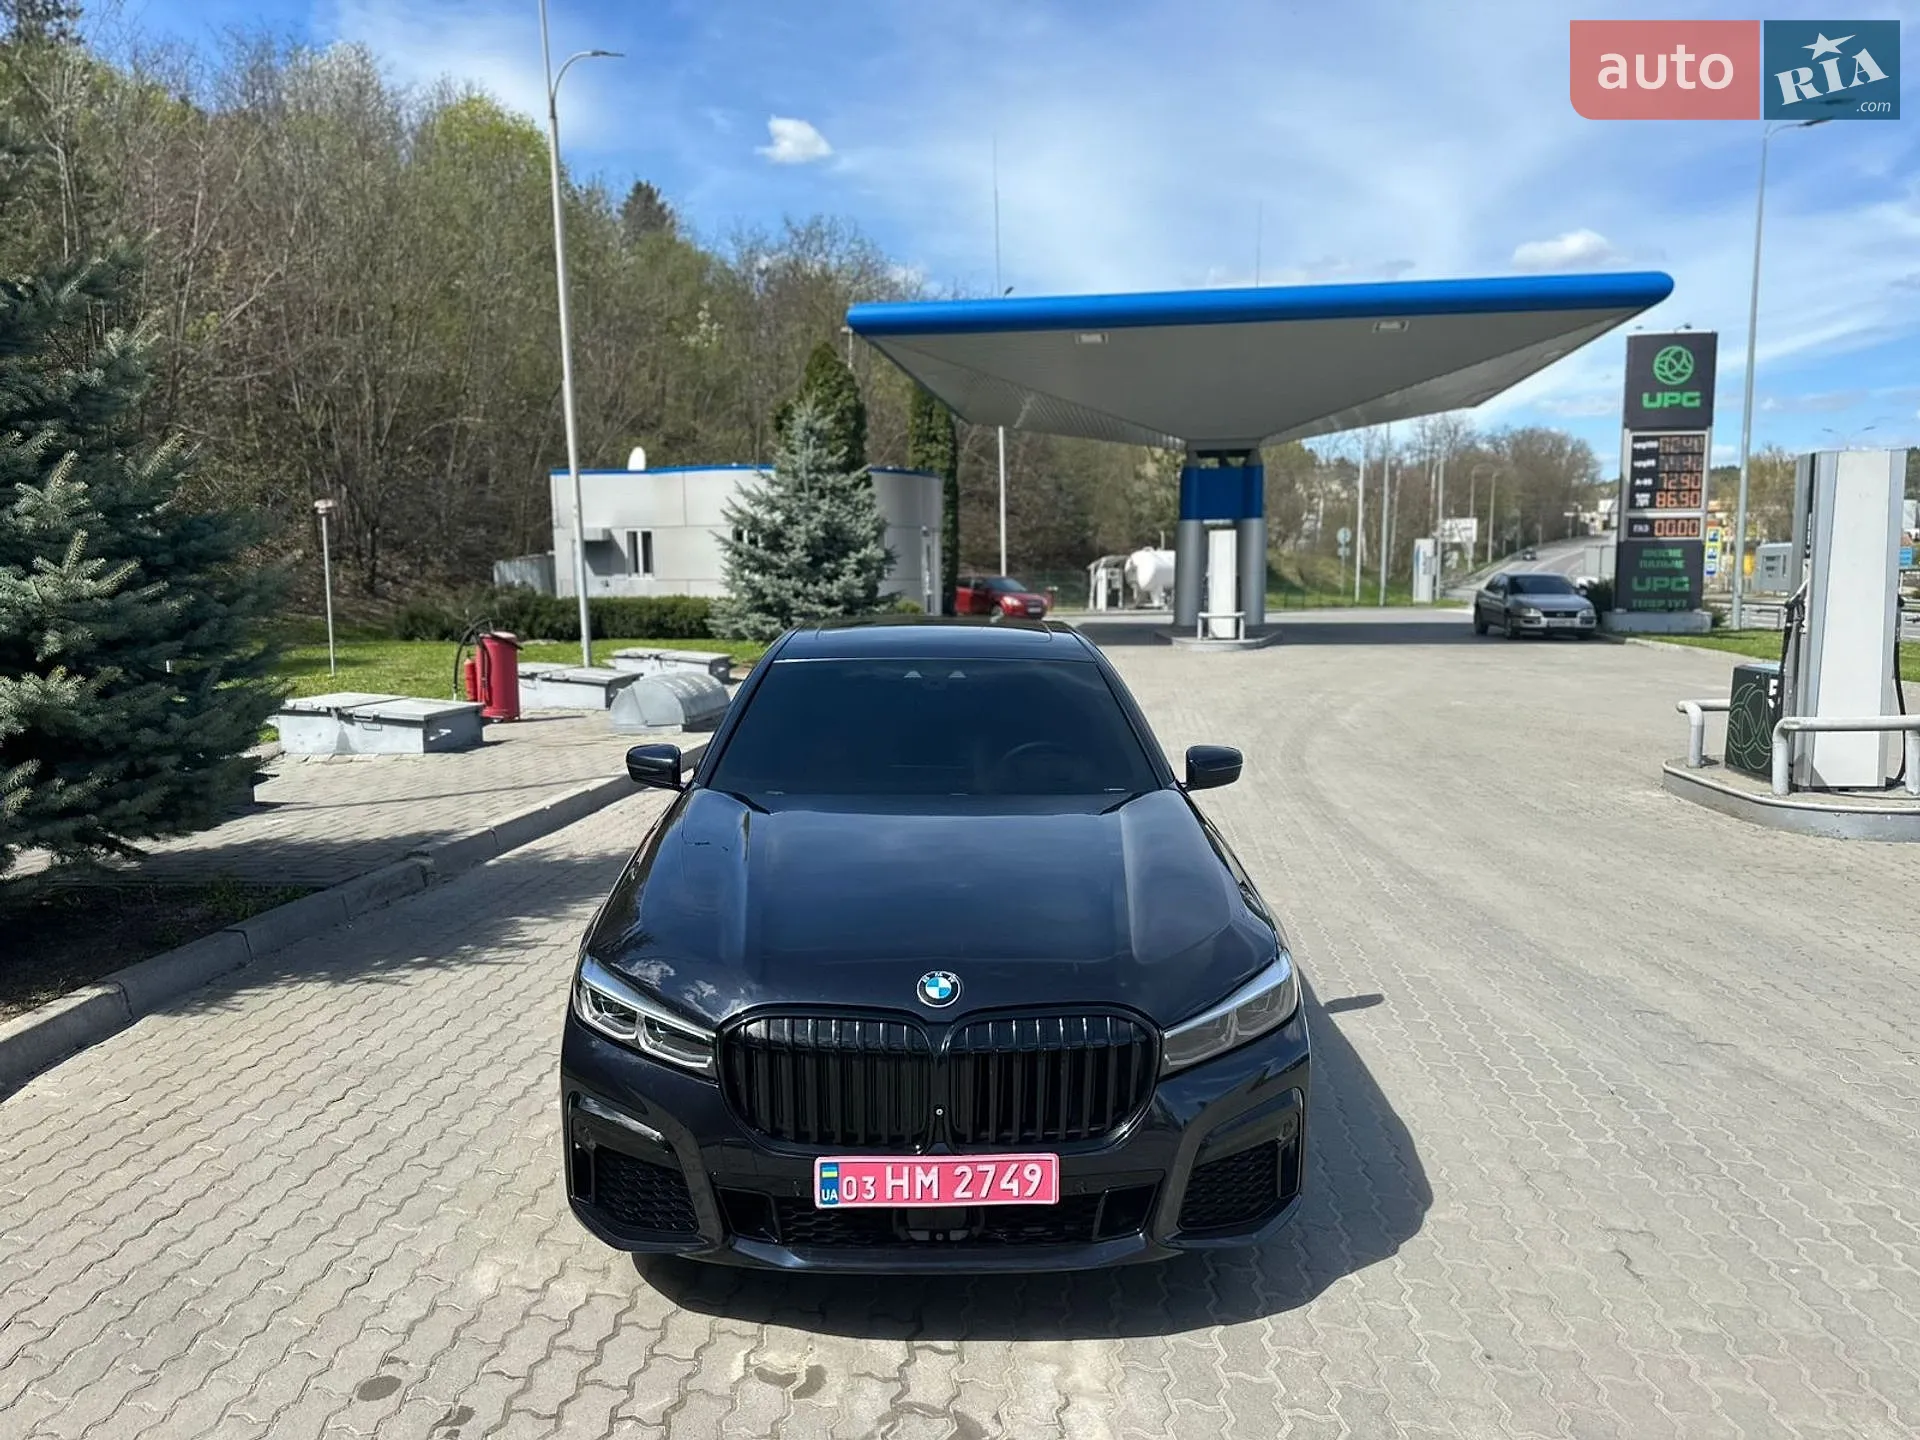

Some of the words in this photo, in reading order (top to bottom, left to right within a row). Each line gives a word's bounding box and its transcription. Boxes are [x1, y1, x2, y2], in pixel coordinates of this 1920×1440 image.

[1641, 391, 1701, 408] UPG
[1631, 576, 1690, 592] UPG
[821, 1189, 838, 1201] UA
[842, 1176, 876, 1201] 03
[886, 1164, 939, 1200] HM
[953, 1163, 1044, 1199] 2749
